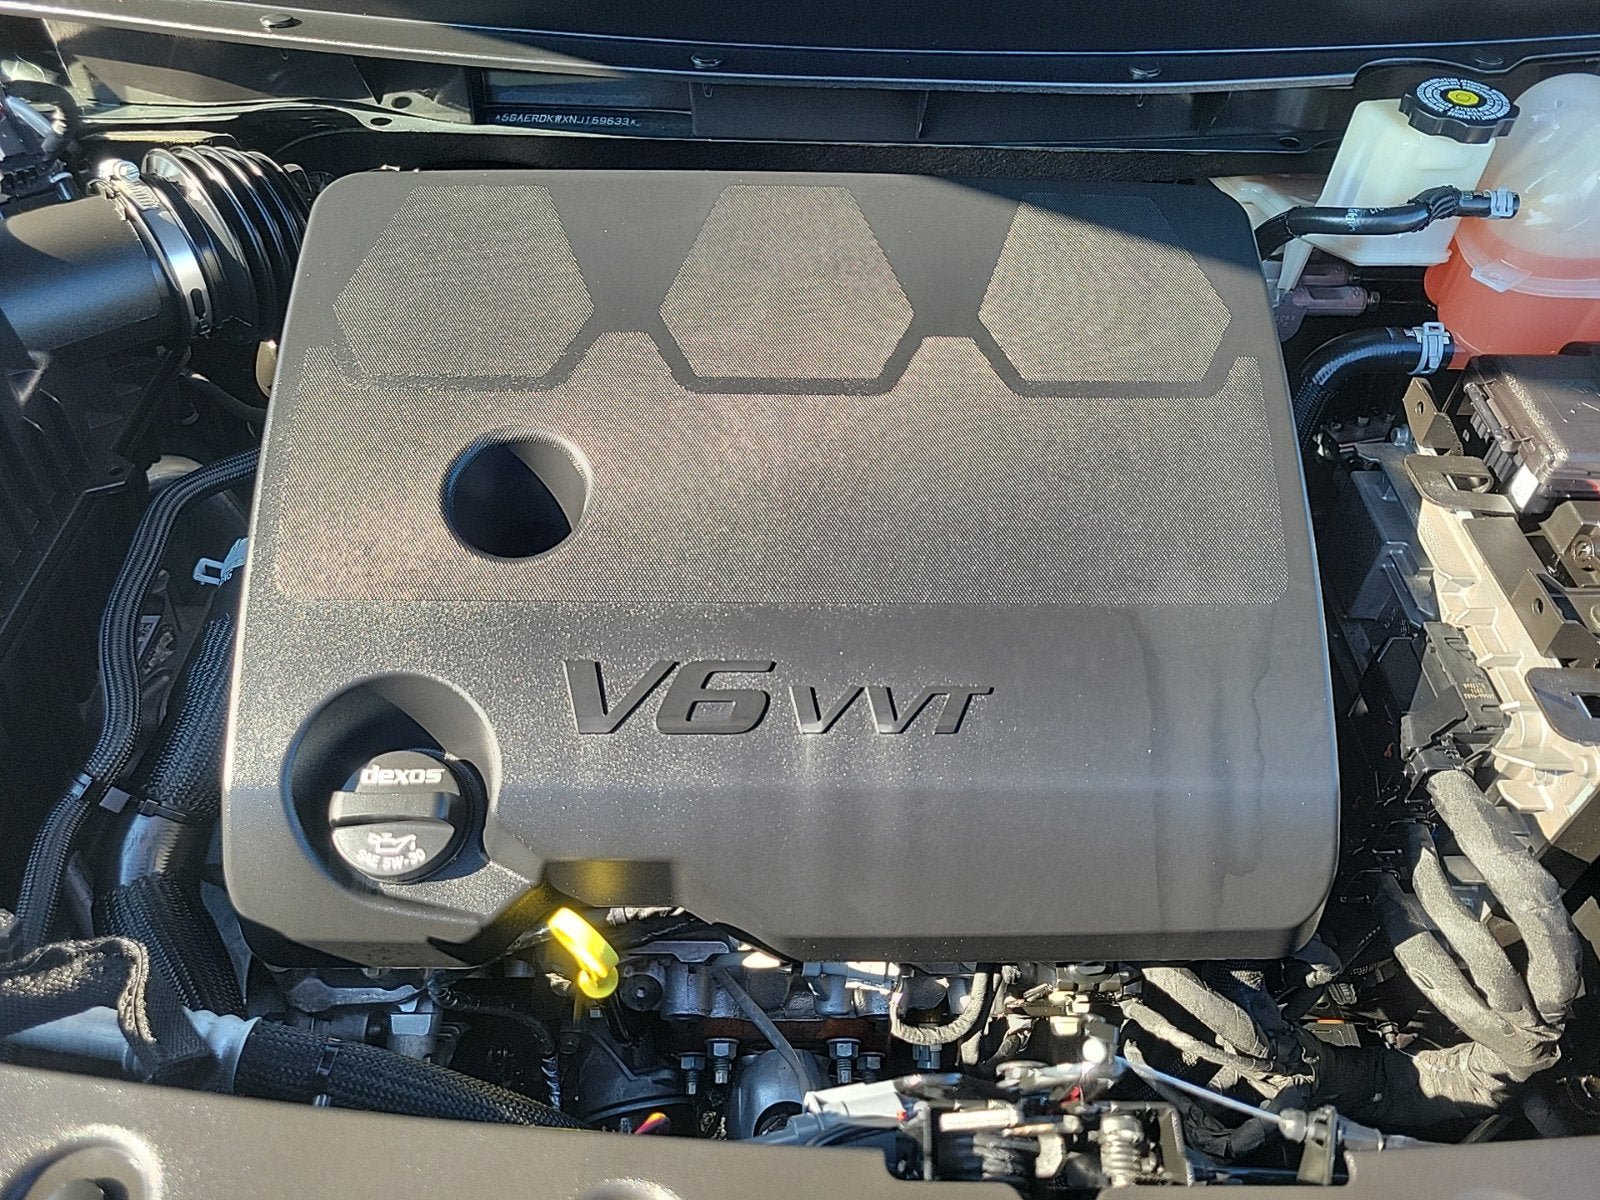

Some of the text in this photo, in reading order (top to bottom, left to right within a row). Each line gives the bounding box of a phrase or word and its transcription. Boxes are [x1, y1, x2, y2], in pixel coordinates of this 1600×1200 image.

[563, 660, 995, 735] V6 VVT
[360, 765, 446, 785] dexos
